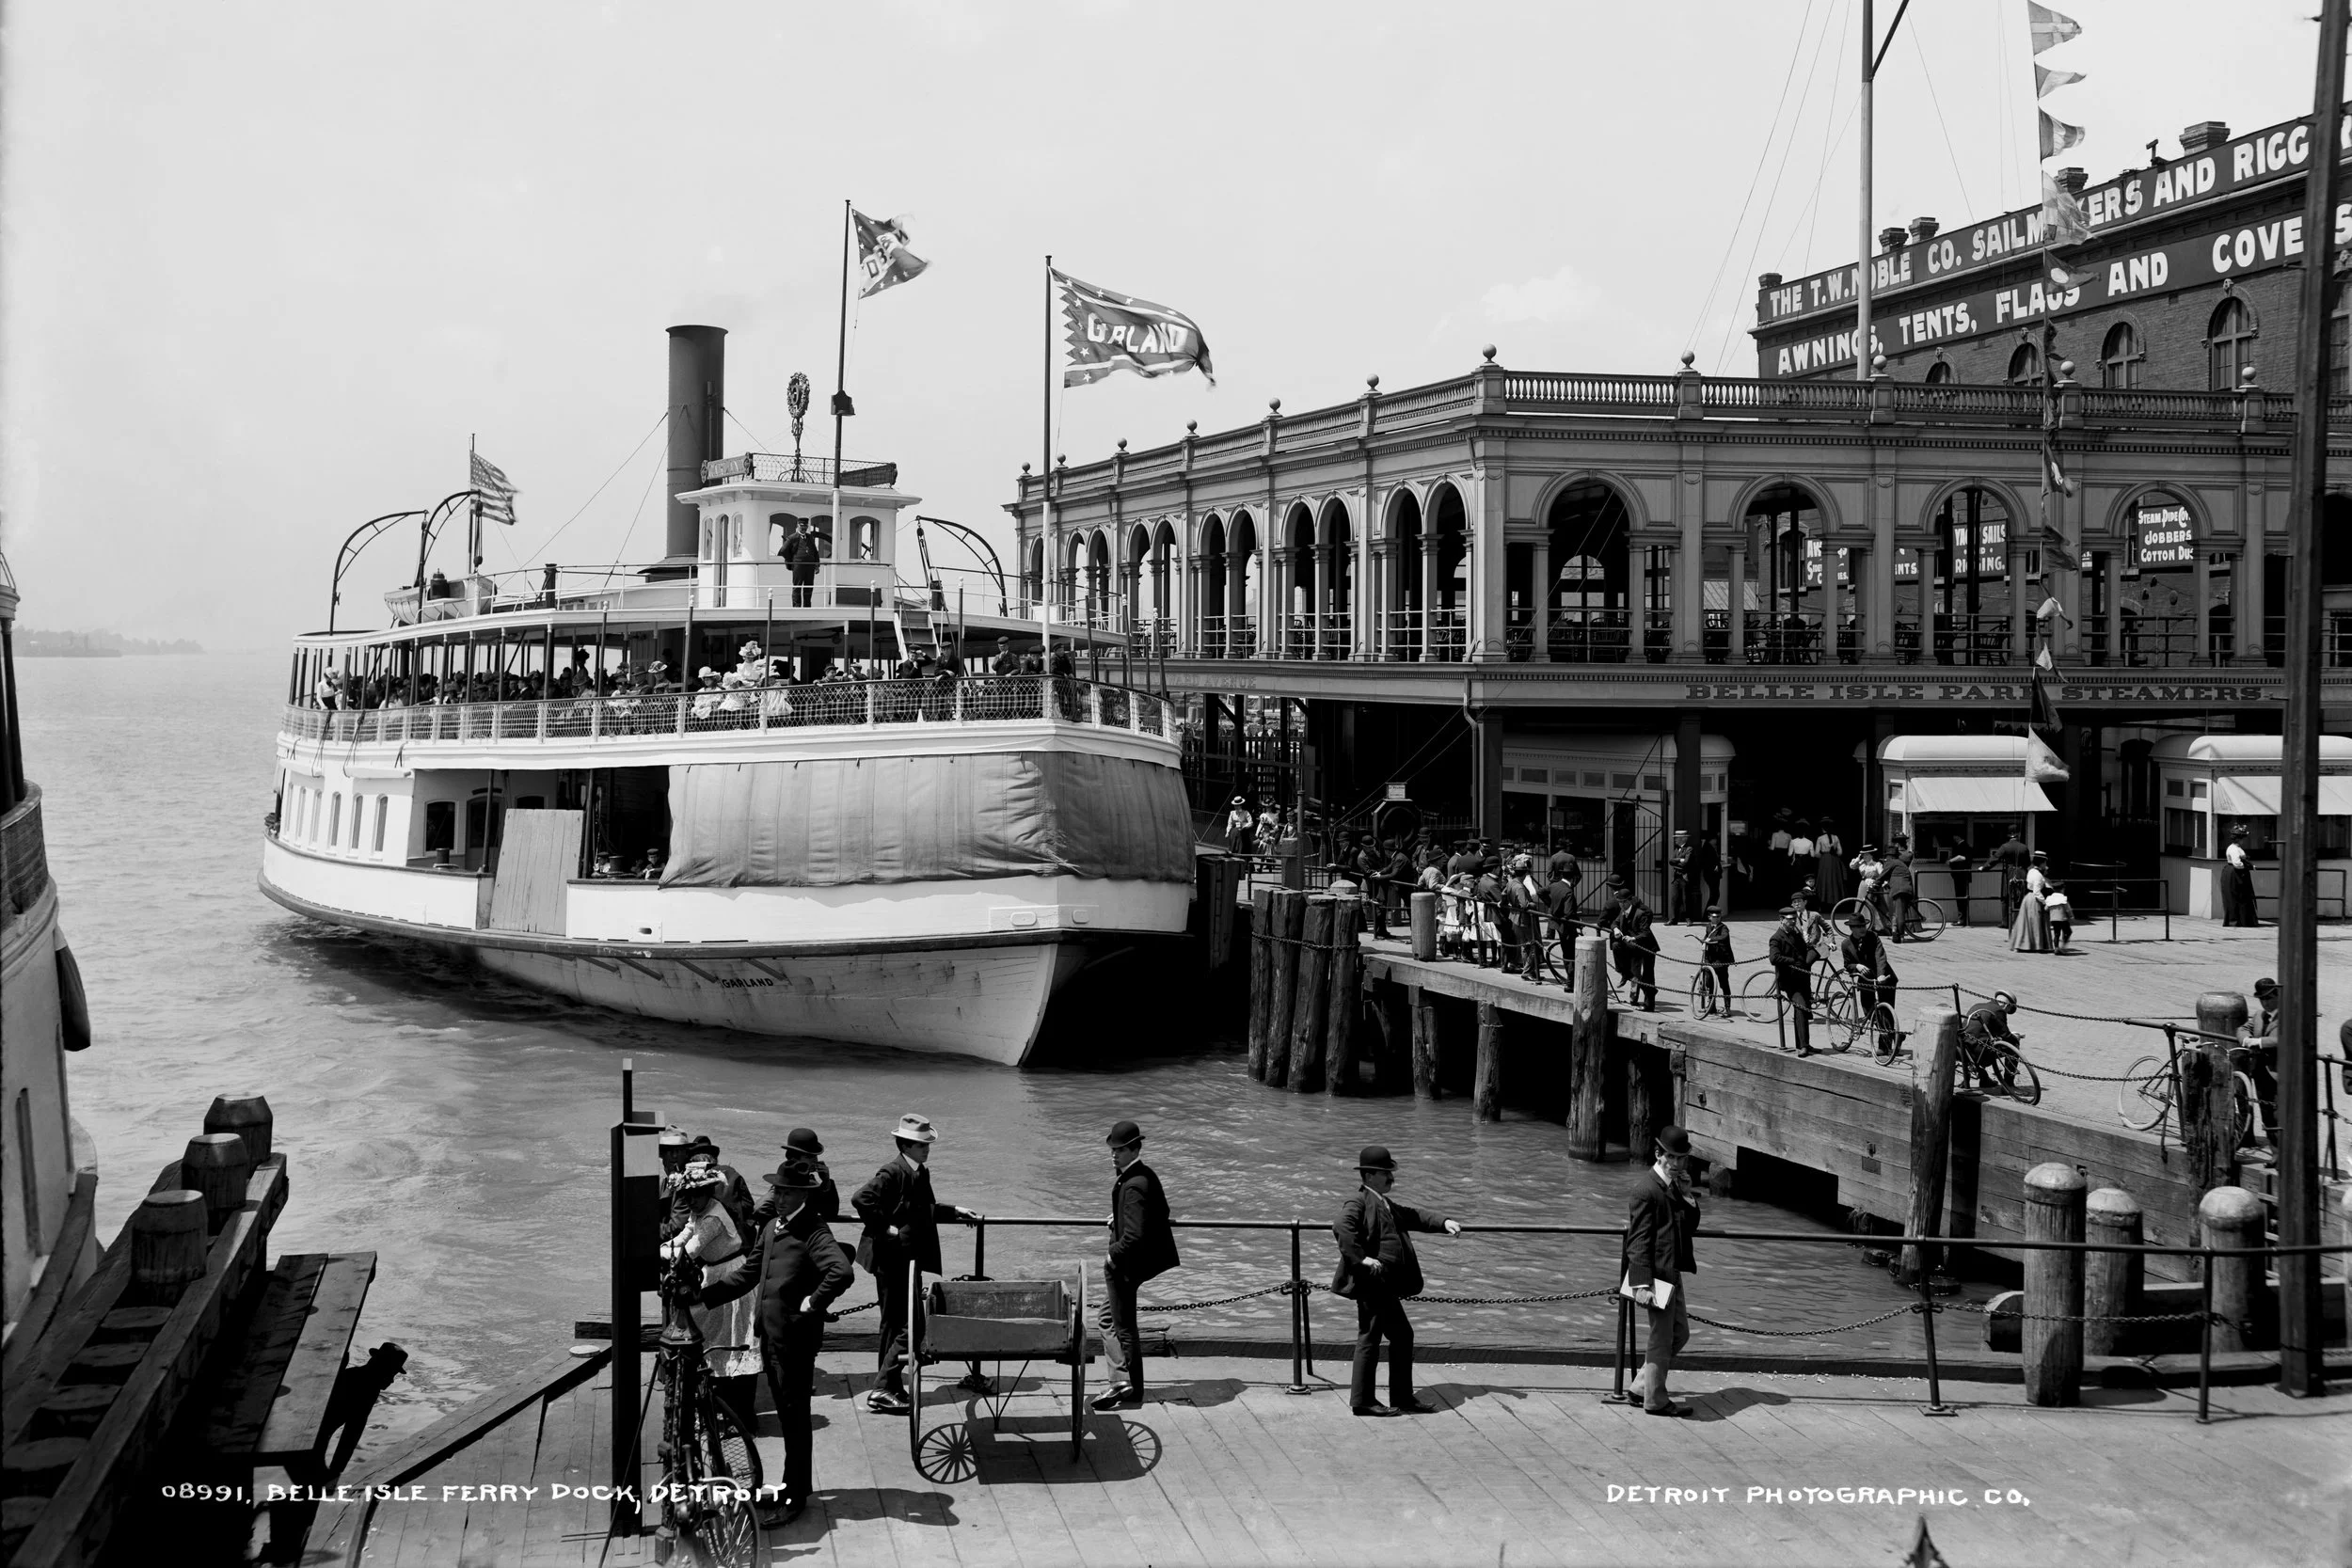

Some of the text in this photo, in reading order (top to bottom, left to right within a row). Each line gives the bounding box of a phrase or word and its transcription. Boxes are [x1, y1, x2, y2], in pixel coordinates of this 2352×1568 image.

[1770, 285, 1802, 317] THE
[1928, 240, 1962, 274] CO.
[1972, 180, 2143, 261] SAILMERS
[2153, 157, 2216, 207] AND
[1899, 302, 1977, 345] TENTS,
[2107, 251, 2169, 297] AND
[2212, 203, 2352, 274] COVES
[2137, 511, 2161, 525] STEAM
[1982, 524, 2006, 545] SAILS
[2145, 530, 2192, 546] JOBBERS
[2140, 548, 2175, 562] COTTON
[1685, 684, 1816, 700] BELLE
[1829, 684, 1925, 700] ISLE
[2061, 686, 2262, 701] STEAMERS
[722, 977, 774, 989] GARLAND
